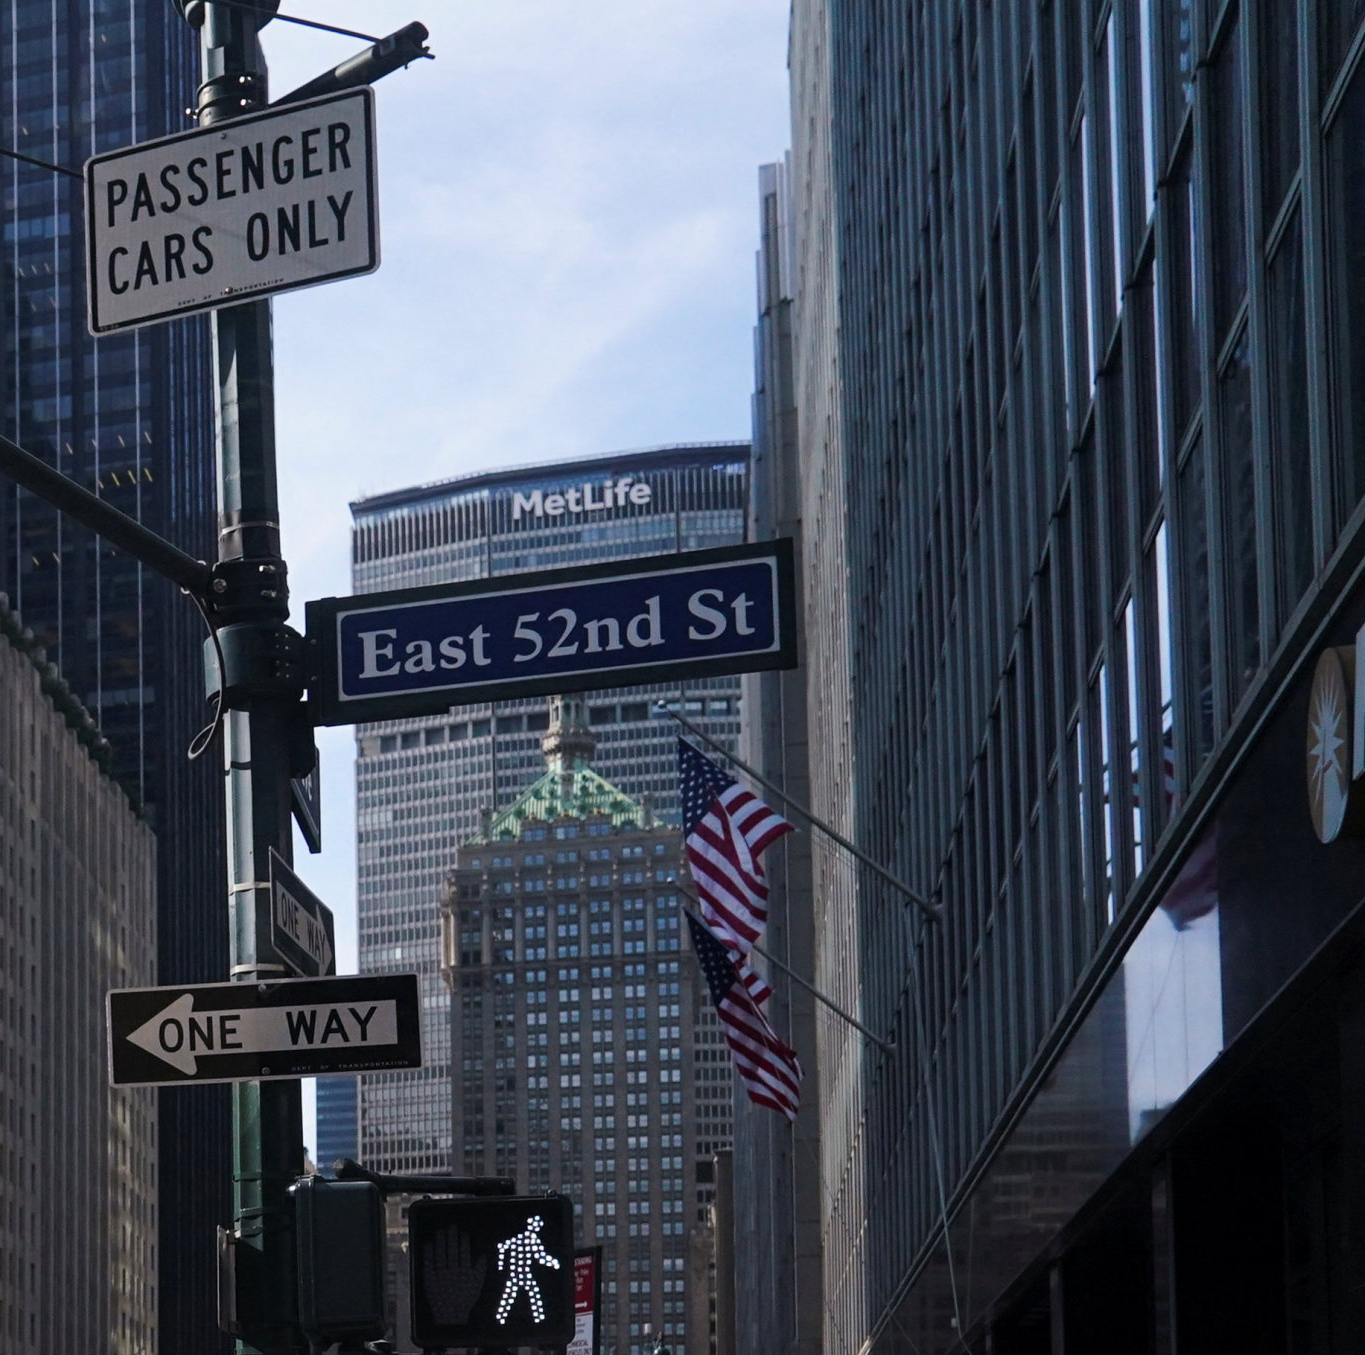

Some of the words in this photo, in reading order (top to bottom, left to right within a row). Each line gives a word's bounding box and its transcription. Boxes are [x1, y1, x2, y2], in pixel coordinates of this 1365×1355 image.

[107, 121, 352, 228] PASSENGER
[107, 225, 214, 295] CARS
[245, 190, 354, 261] ONLY
[512, 478, 653, 520] MetLife
[357, 623, 492, 679] East
[512, 595, 666, 664] 52nd
[687, 588, 757, 641] St
[280, 891, 300, 941] ONE
[307, 921, 329, 965] WAY
[158, 1013, 244, 1053] ONE
[285, 1005, 378, 1046] WAY
[338, 1060, 409, 1069] TRANSPORTATION
